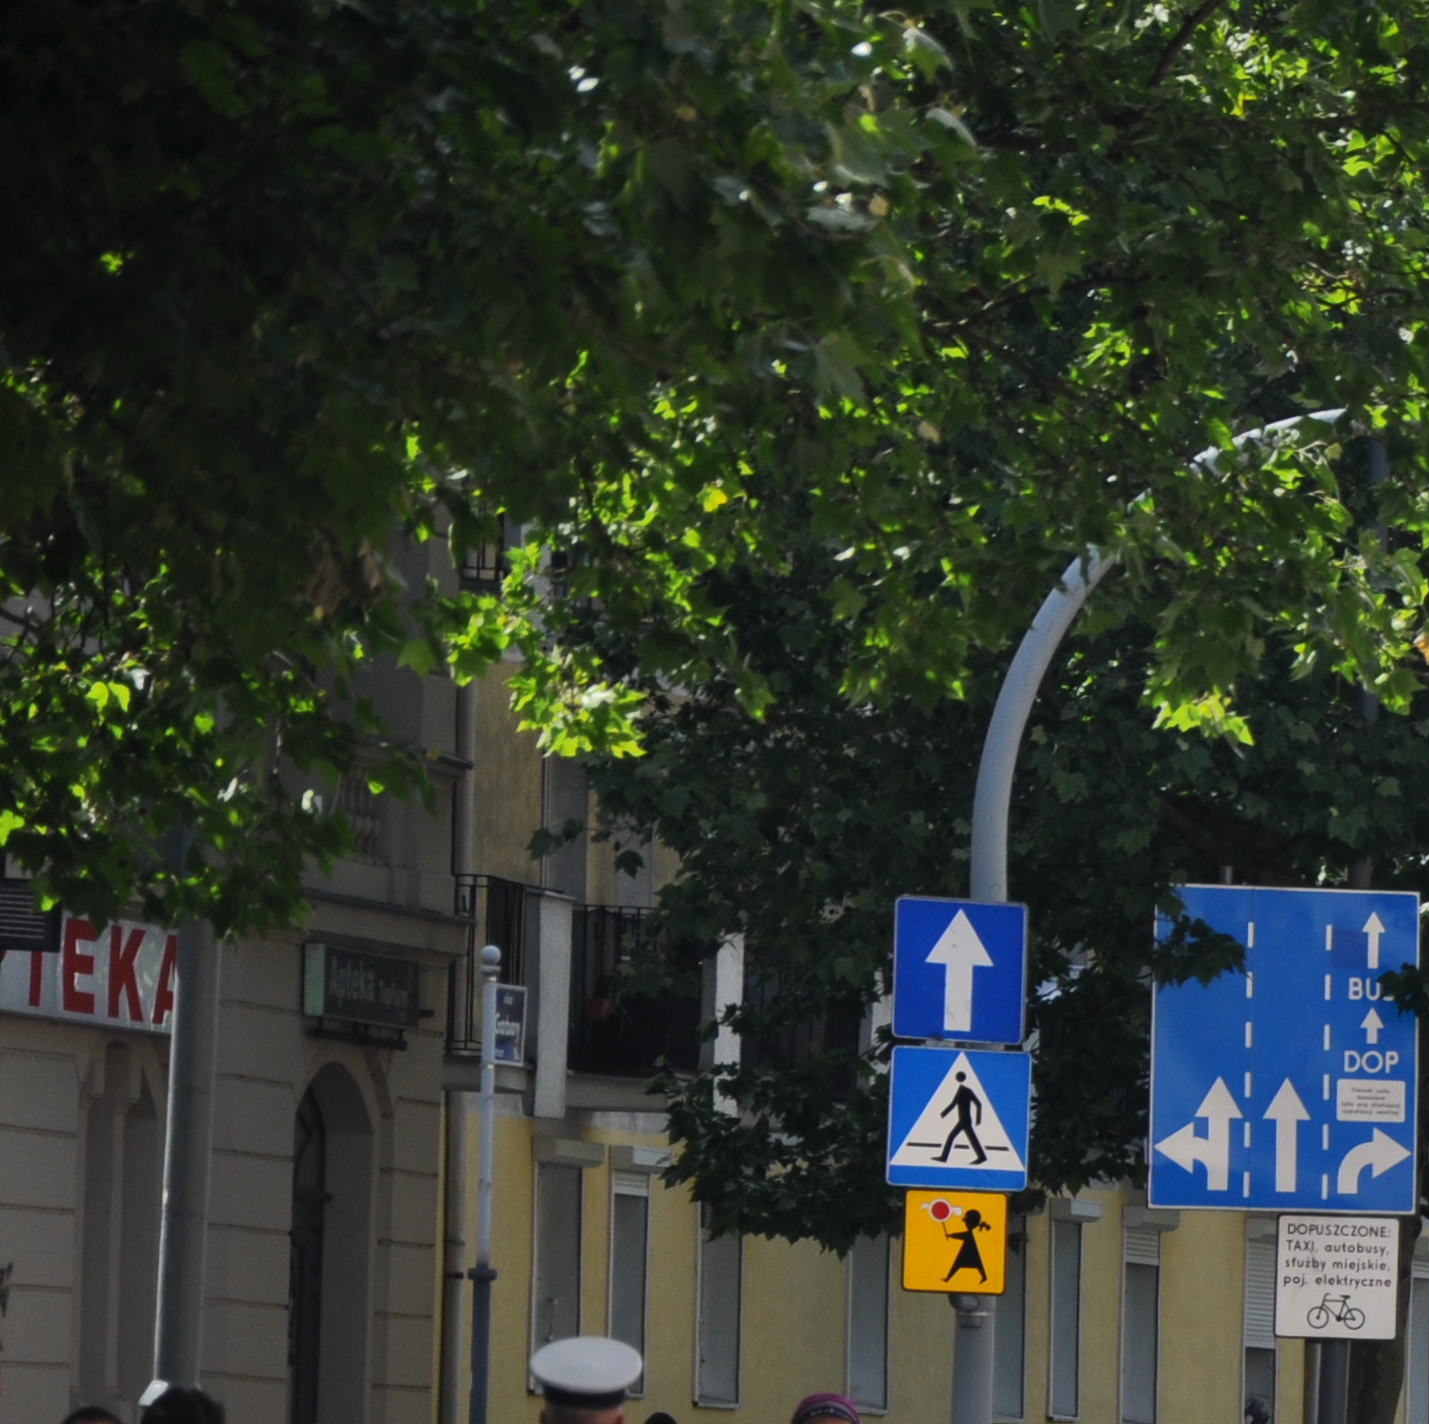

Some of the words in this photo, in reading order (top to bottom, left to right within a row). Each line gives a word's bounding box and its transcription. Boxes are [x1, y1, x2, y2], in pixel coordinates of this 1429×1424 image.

[0, 918, 178, 1025] TEKA
[1348, 977, 1390, 1001] BU
[1343, 1050, 1399, 1073] DOP
[1287, 1223, 1391, 1238] DOPUSZCZONE:
[1286, 1240, 1319, 1253] TAXI,
[1324, 1242, 1389, 1257] autobusy,
[1285, 1257, 1327, 1271] służby
[1332, 1259, 1390, 1272] miejskie,
[1315, 1274, 1392, 1289] elektryczne
